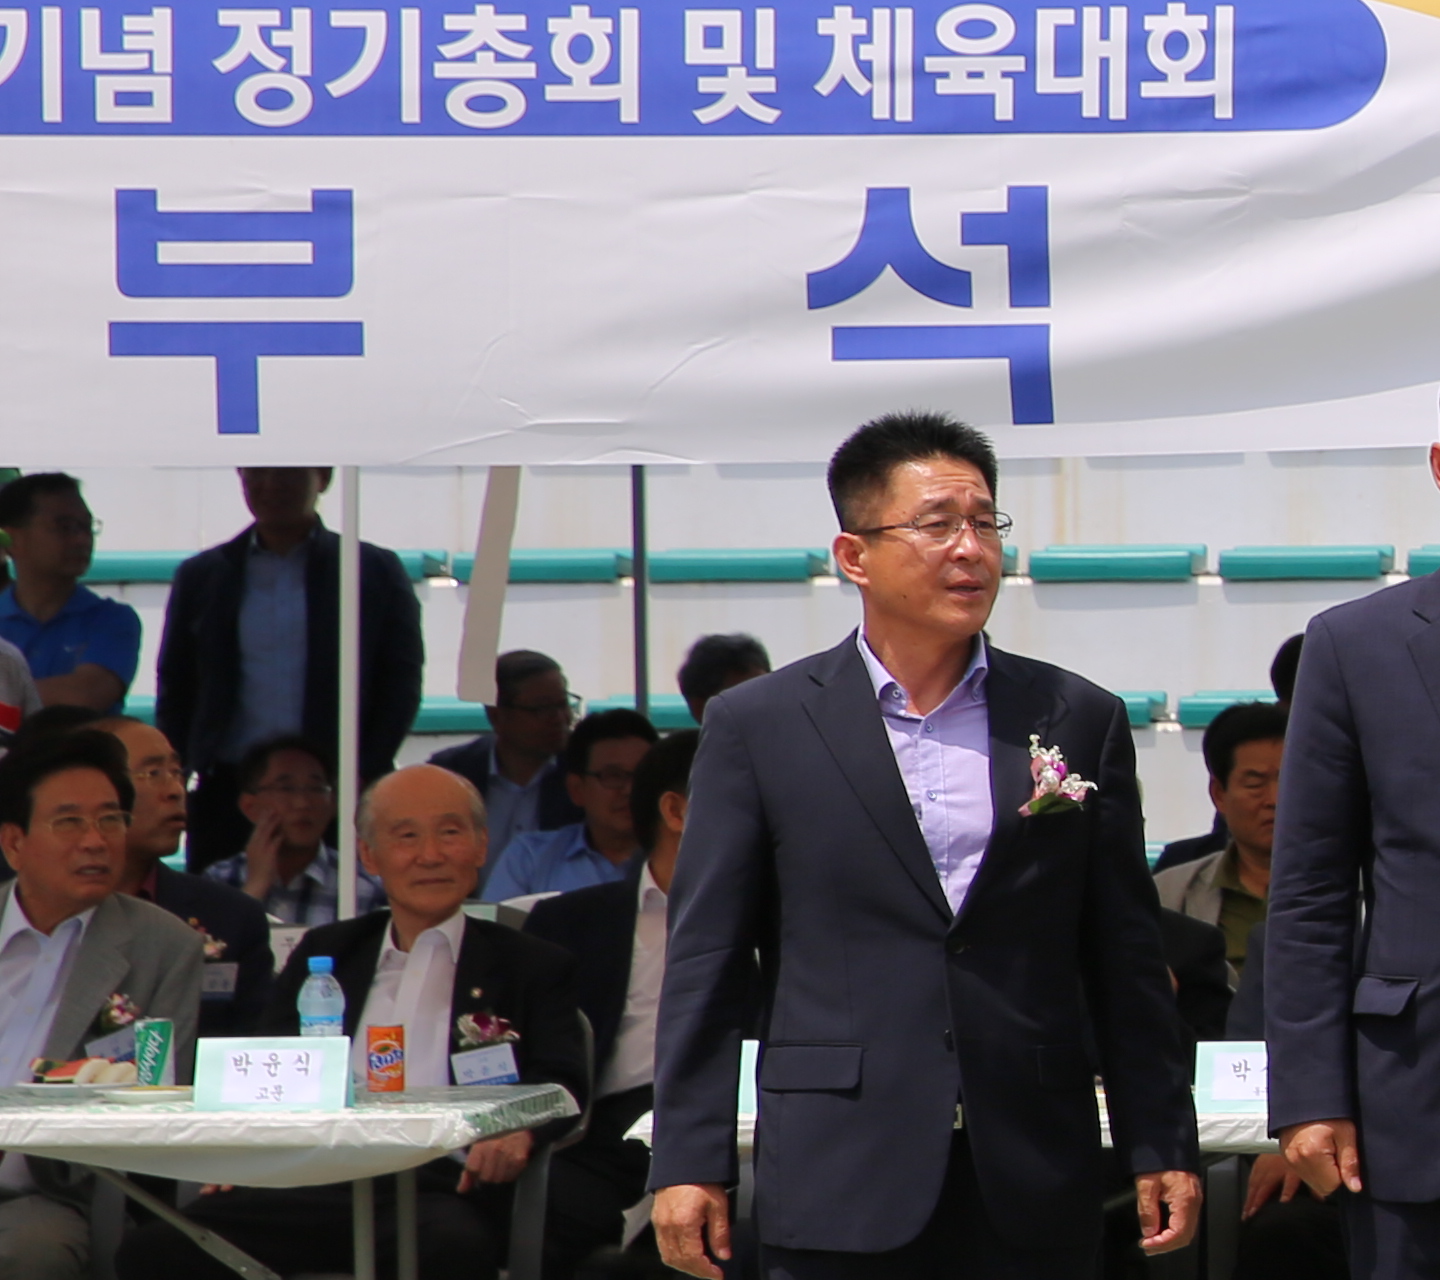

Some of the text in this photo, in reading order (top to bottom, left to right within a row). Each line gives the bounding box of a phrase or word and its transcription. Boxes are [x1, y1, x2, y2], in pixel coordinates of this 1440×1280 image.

[0, 2, 1234, 128] 기념 정기총회 및 체육대회
[111, 187, 1052, 433] 부 석
[232, 1052, 253, 1076] 박
[293, 1051, 310, 1076] 식
[1231, 1059, 1252, 1082] 박
